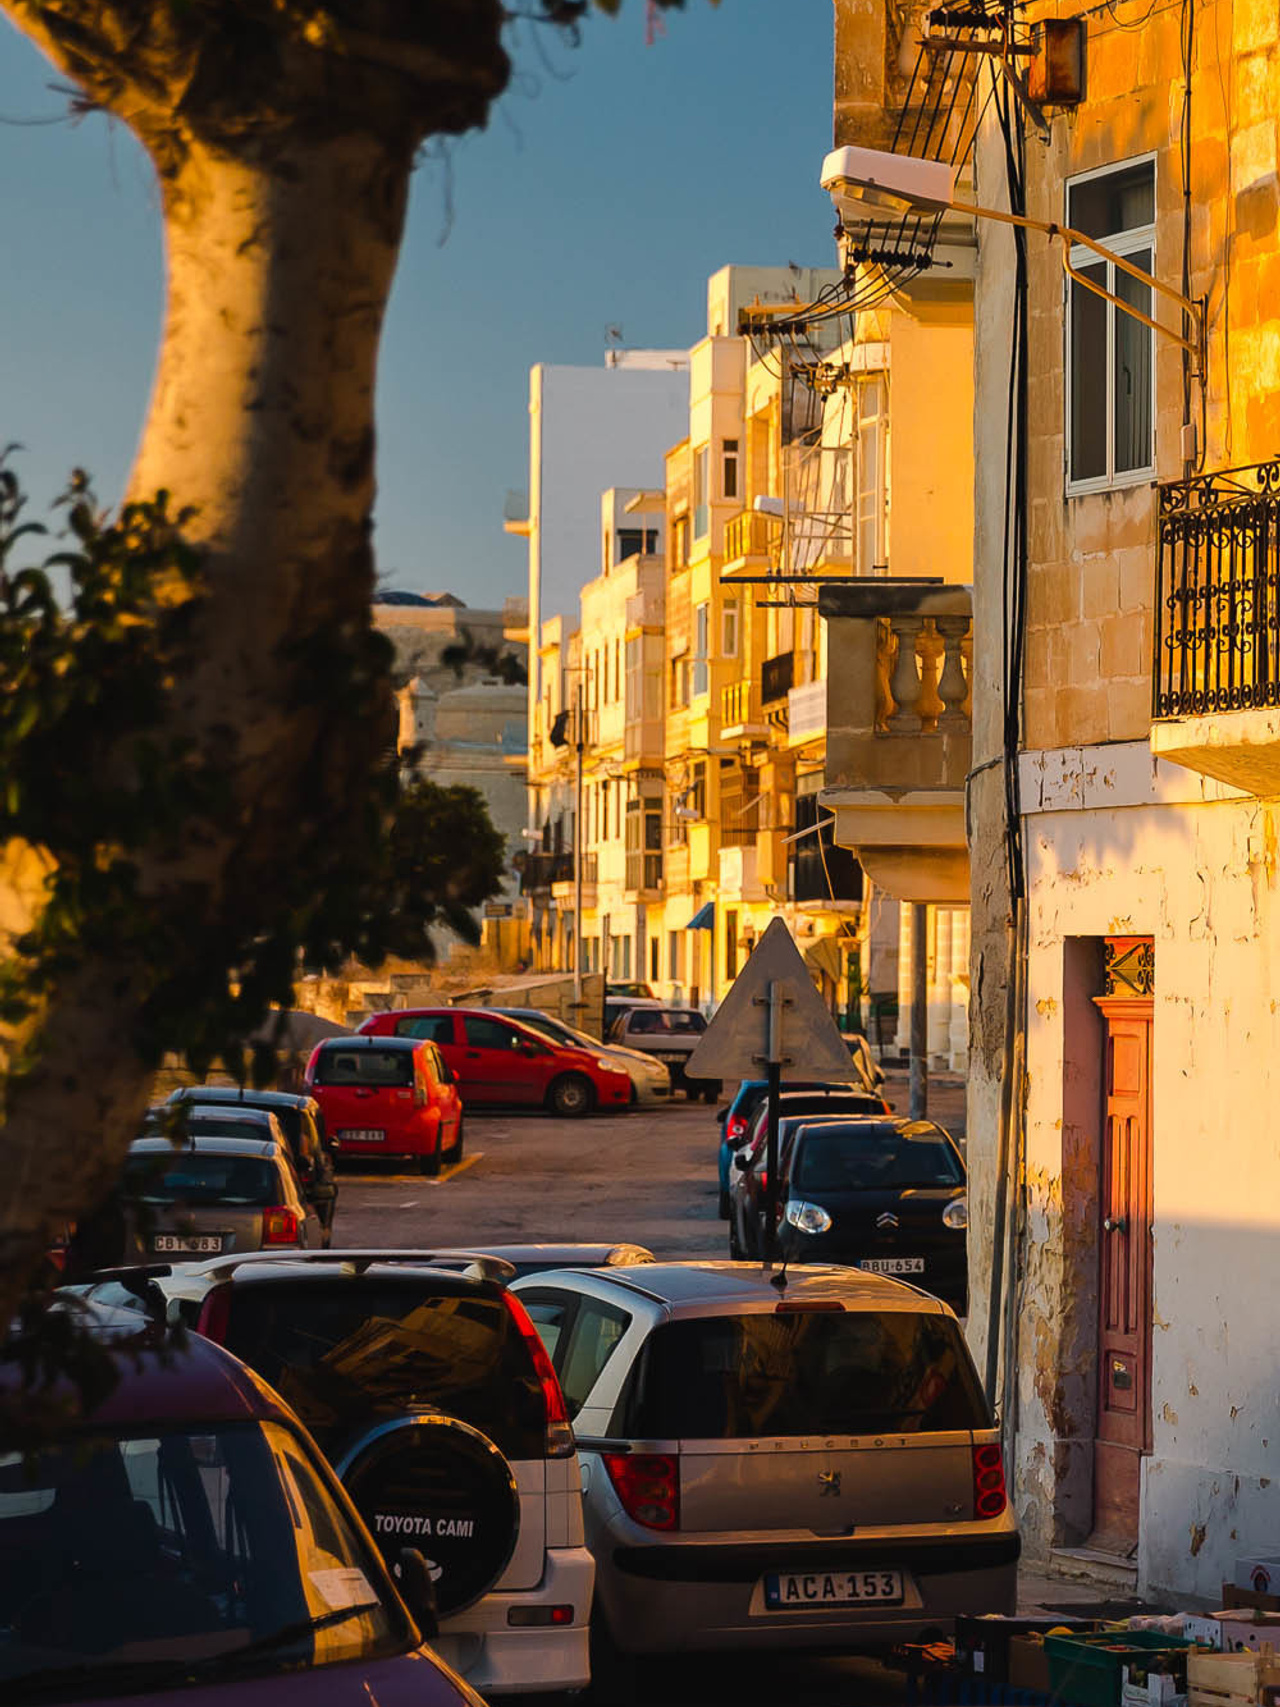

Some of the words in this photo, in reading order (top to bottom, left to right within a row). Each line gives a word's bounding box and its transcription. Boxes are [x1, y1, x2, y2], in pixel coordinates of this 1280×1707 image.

[750, 1438, 910, 1450] PEUGEOT
[374, 1514, 432, 1535] TOYOTA
[436, 1518, 474, 1538] CAMI
